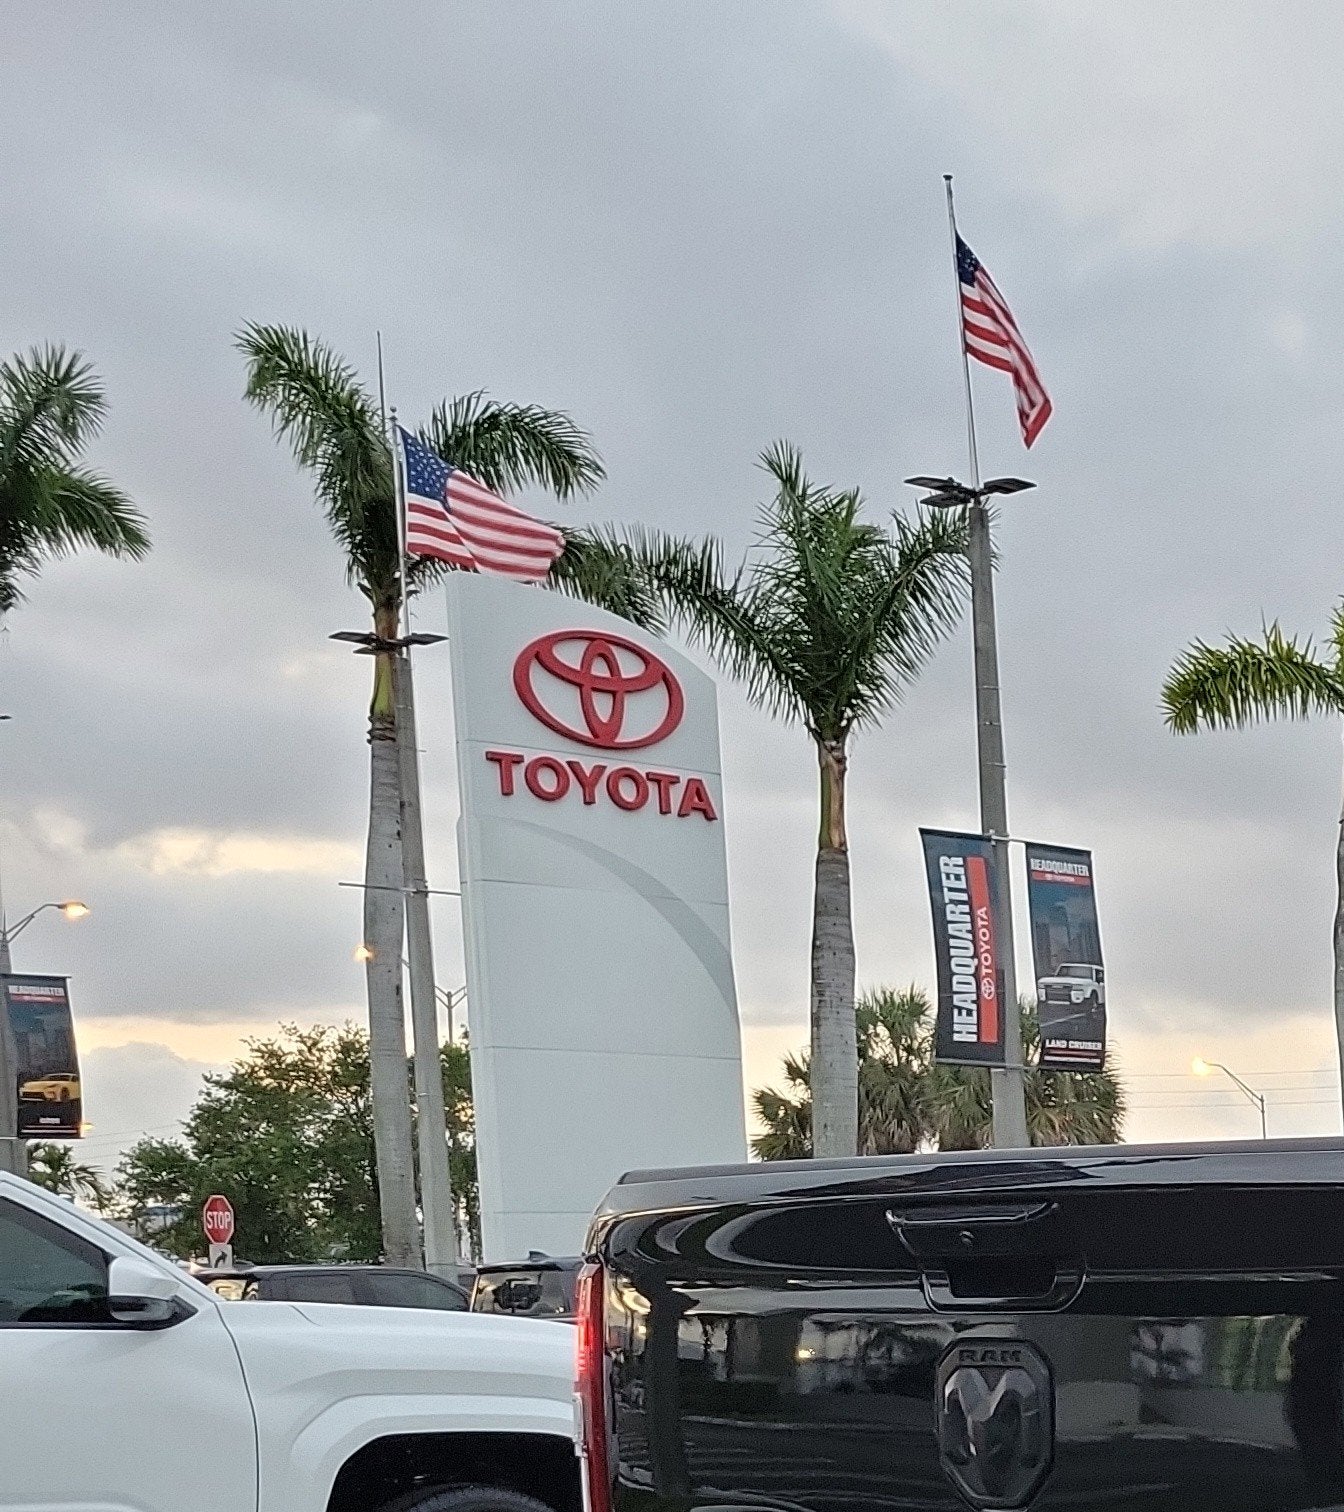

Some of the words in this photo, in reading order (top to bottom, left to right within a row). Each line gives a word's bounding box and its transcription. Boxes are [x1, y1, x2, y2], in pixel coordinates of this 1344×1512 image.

[485, 751, 718, 821] TOYOTA
[1030, 858, 1090, 877] HEADQUARTER
[939, 854, 978, 1043] HEADQUARTER
[976, 906, 993, 975] TOYOTA
[206, 1210, 231, 1229] STOP
